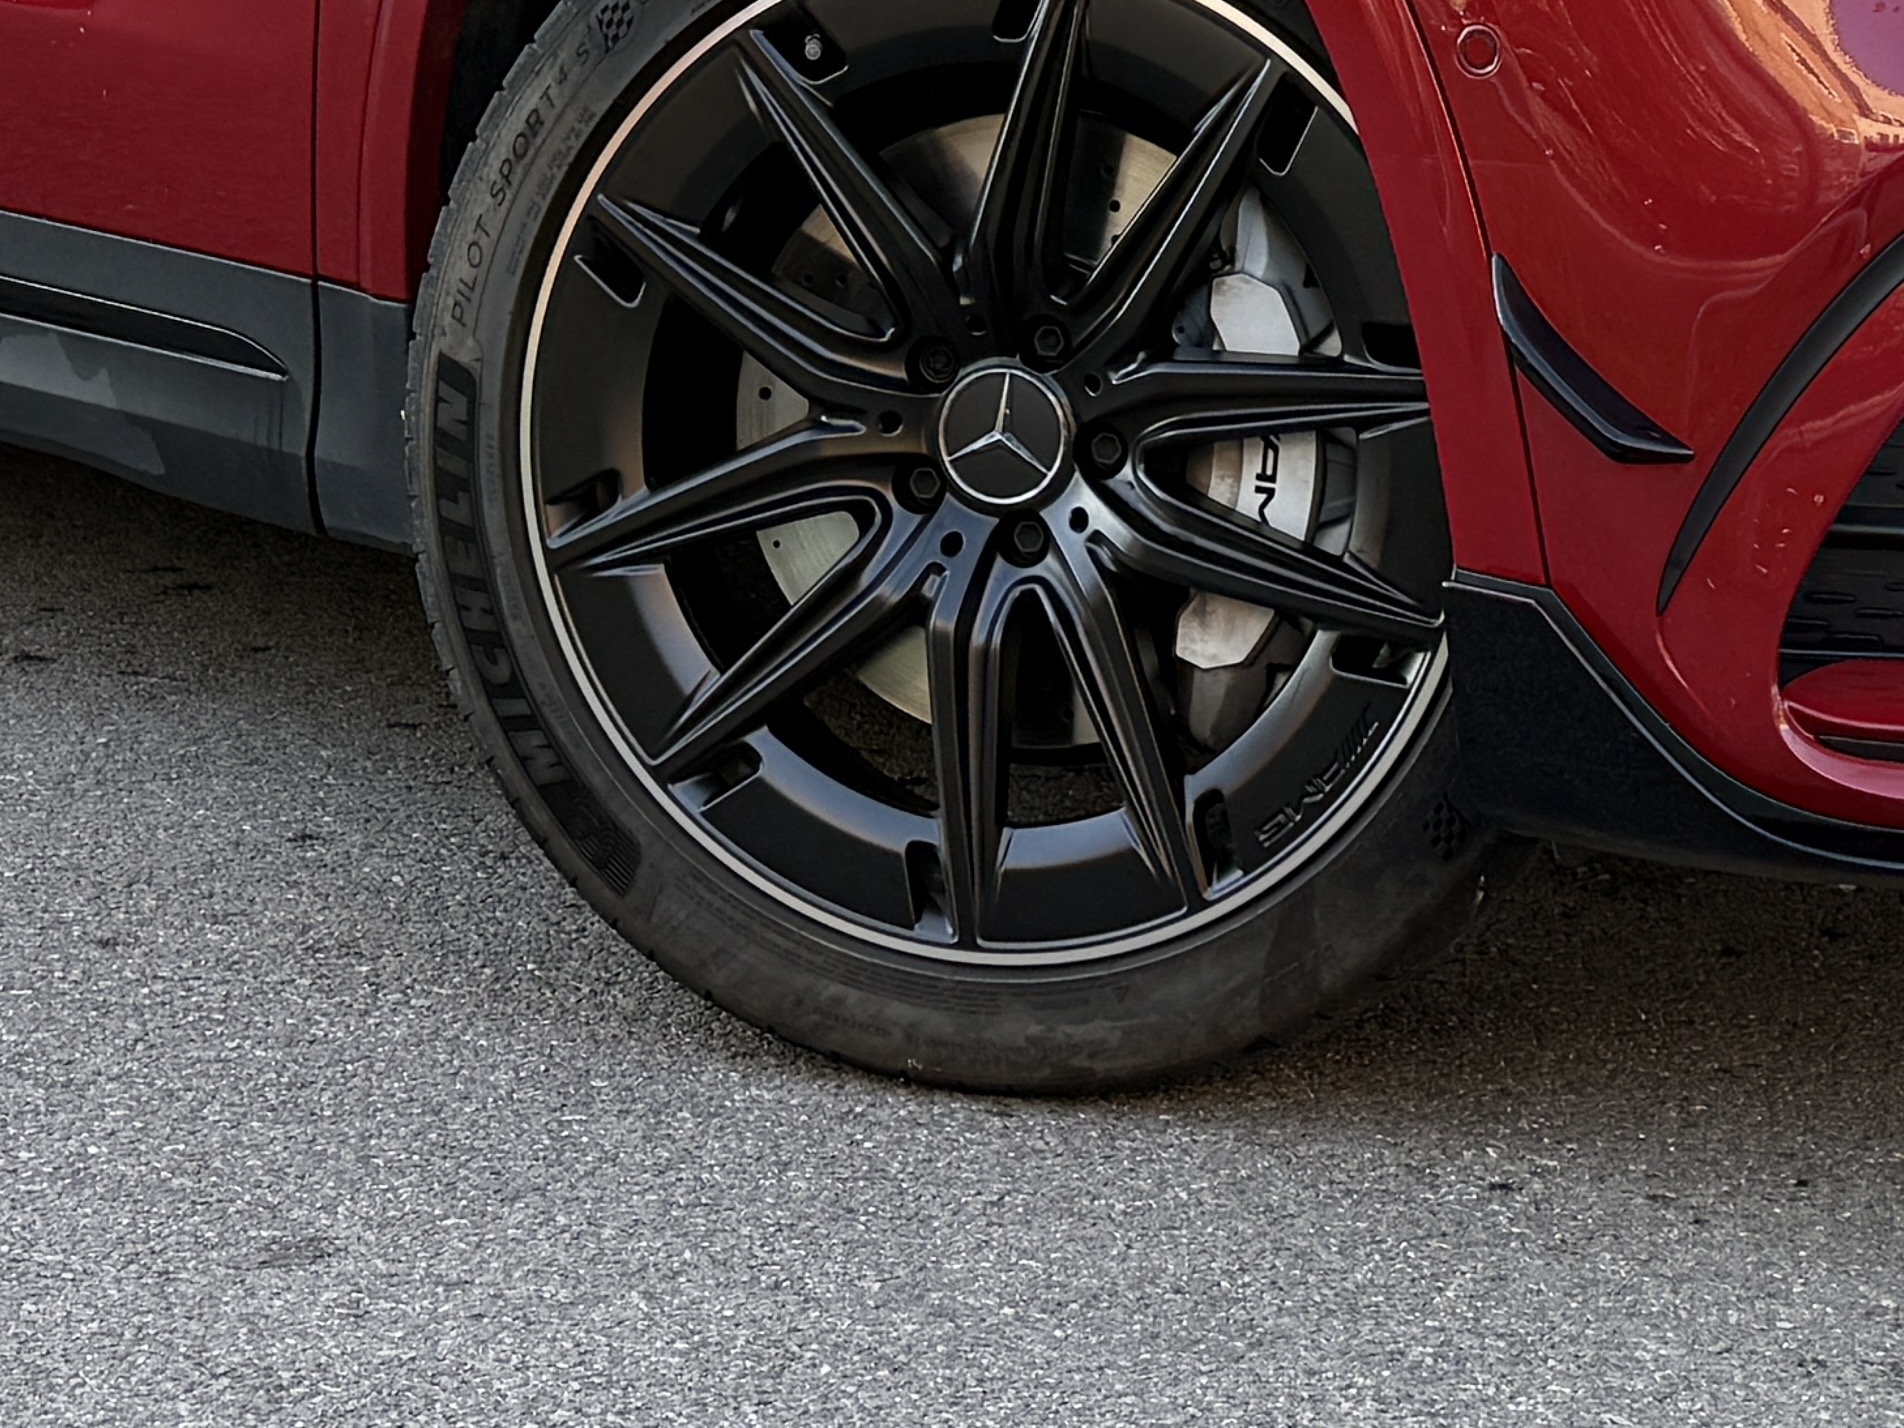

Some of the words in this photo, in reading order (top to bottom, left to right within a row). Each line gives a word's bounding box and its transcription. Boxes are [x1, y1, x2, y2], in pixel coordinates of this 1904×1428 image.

[450, 214, 492, 328] PILOT
[490, 85, 555, 207] SPORT
[434, 376, 573, 788] MICHELIN
